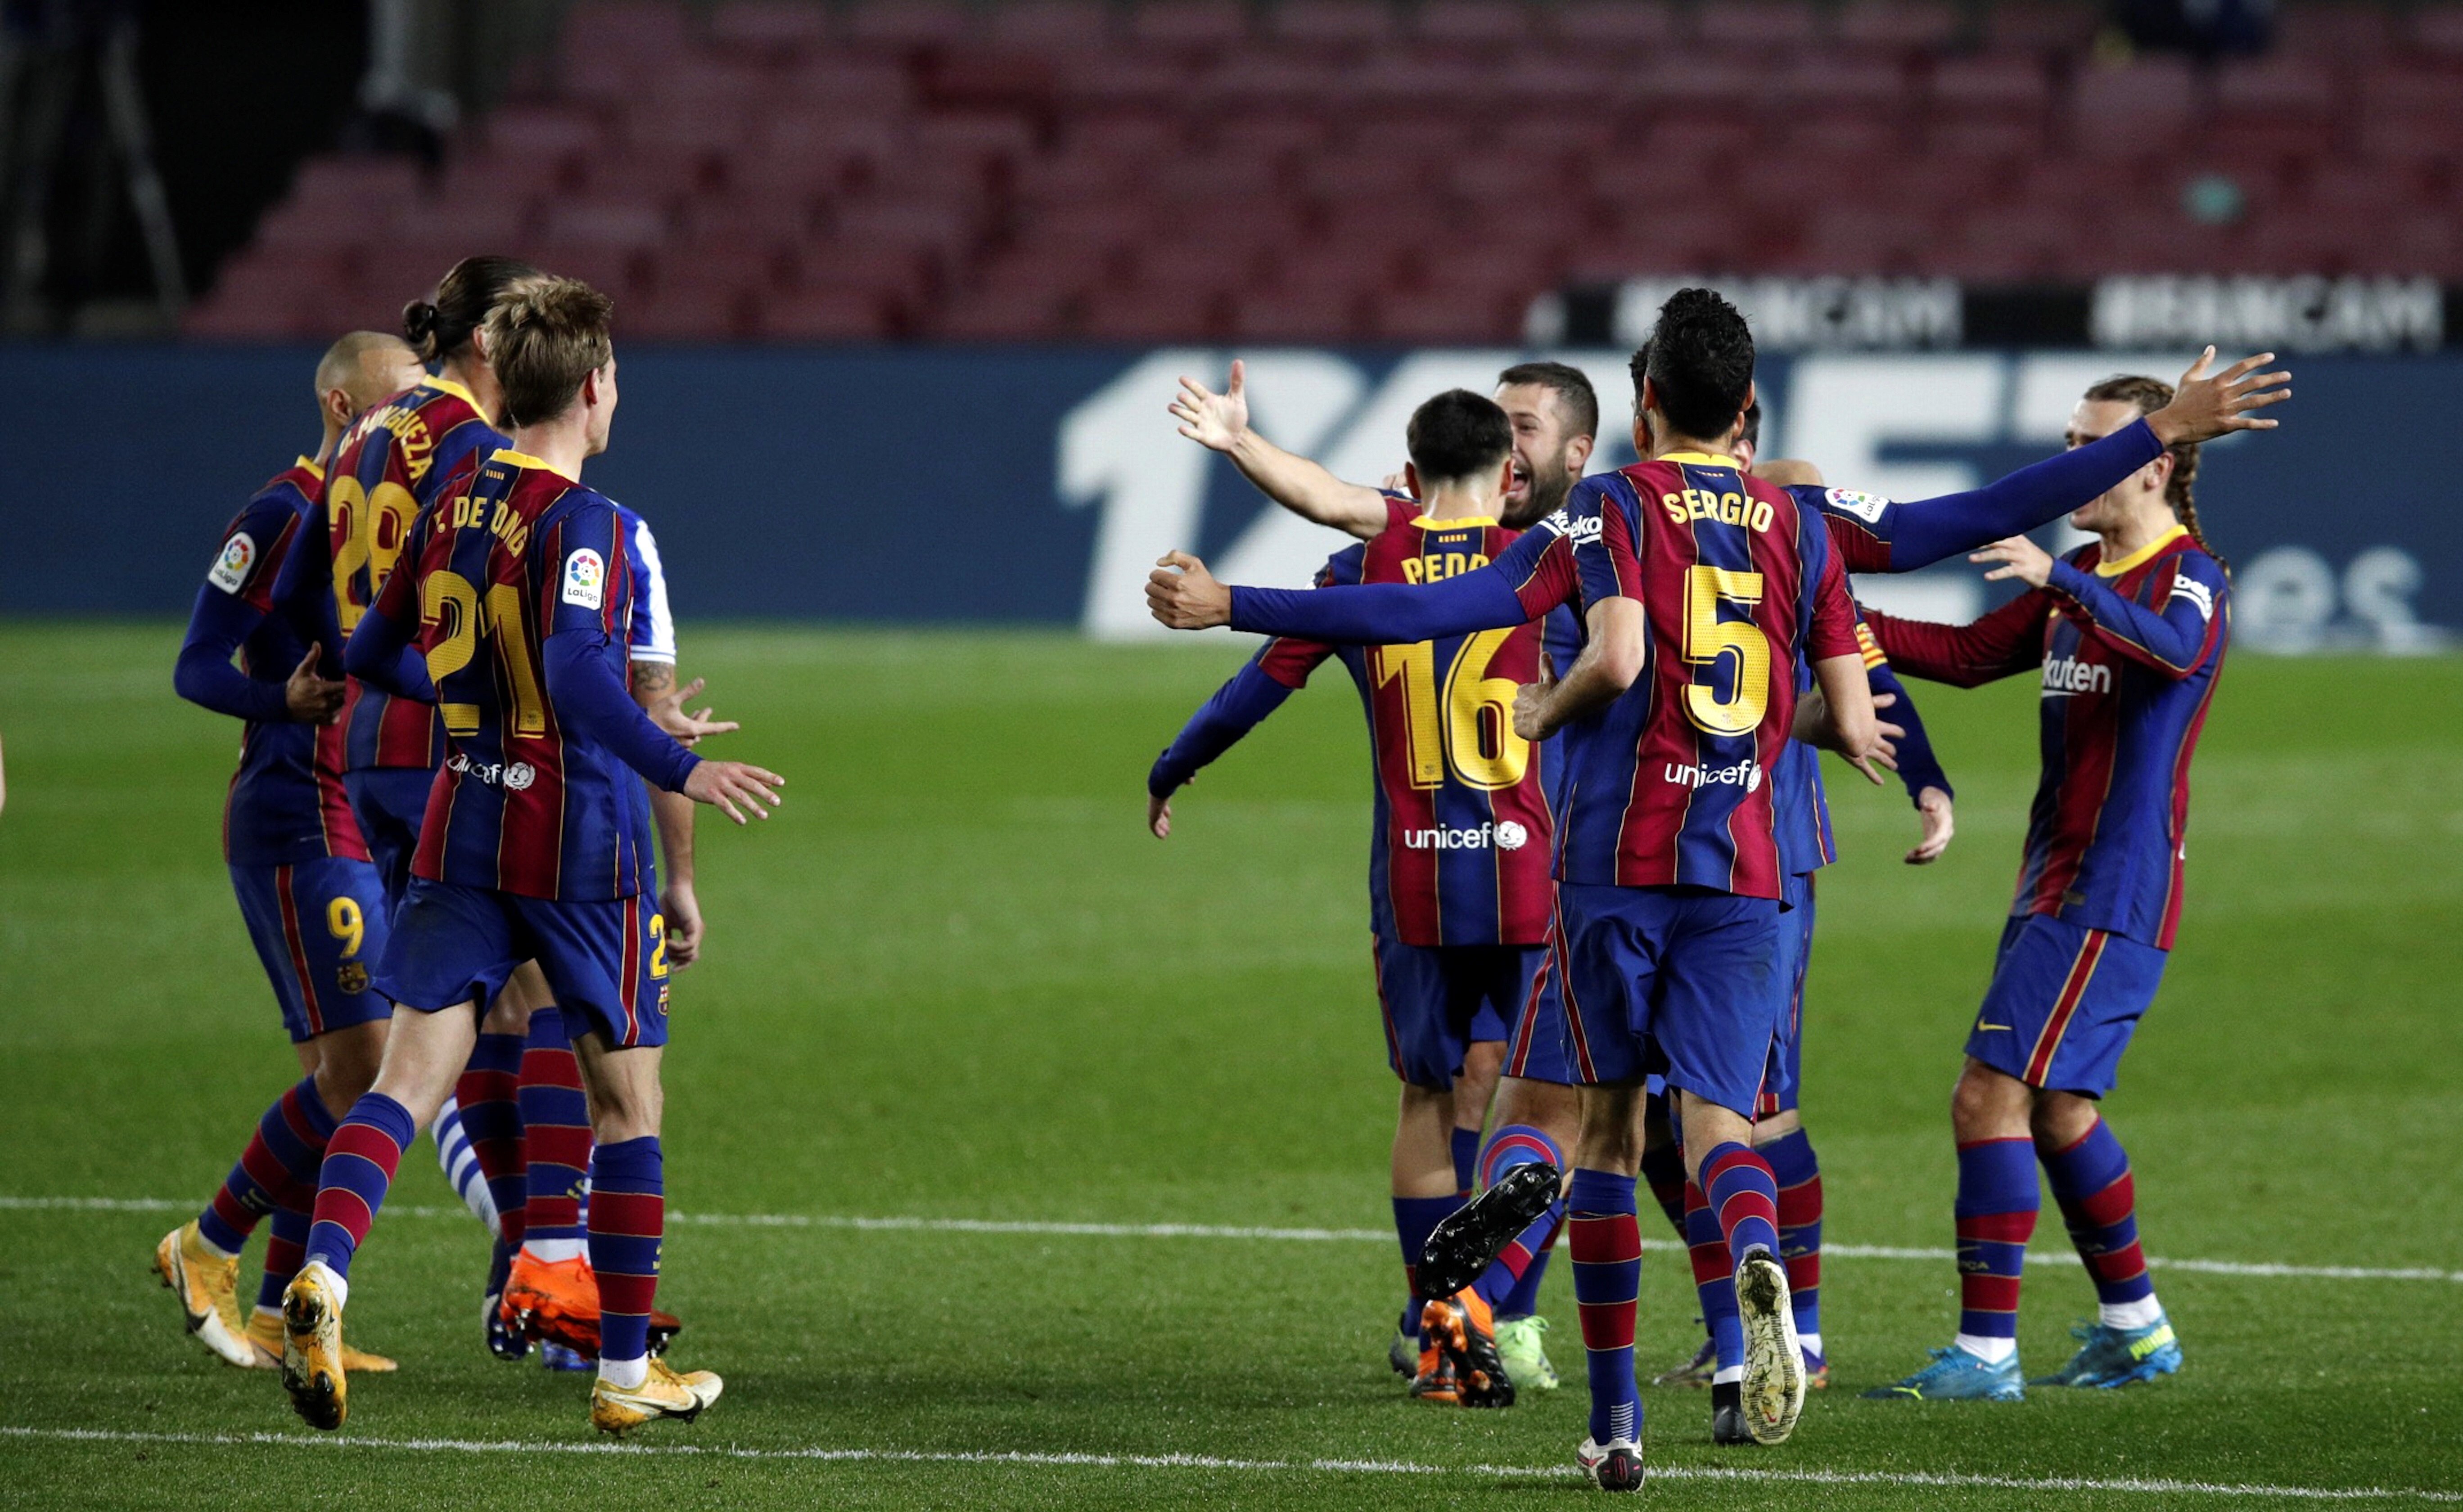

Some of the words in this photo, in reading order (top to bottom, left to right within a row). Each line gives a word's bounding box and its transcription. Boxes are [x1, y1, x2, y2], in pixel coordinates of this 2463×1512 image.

[452, 497, 487, 529] DE
[490, 499, 528, 558] ONG
[1662, 489, 1774, 533] SERGIO
[568, 587, 598, 603] LaLiga
[421, 569, 545, 739] 21
[1681, 565, 1770, 737] 5
[1375, 626, 1530, 791] 16
[1664, 759, 1752, 789] unicef
[1404, 821, 1492, 849] unicef
[326, 896, 364, 958] 9
